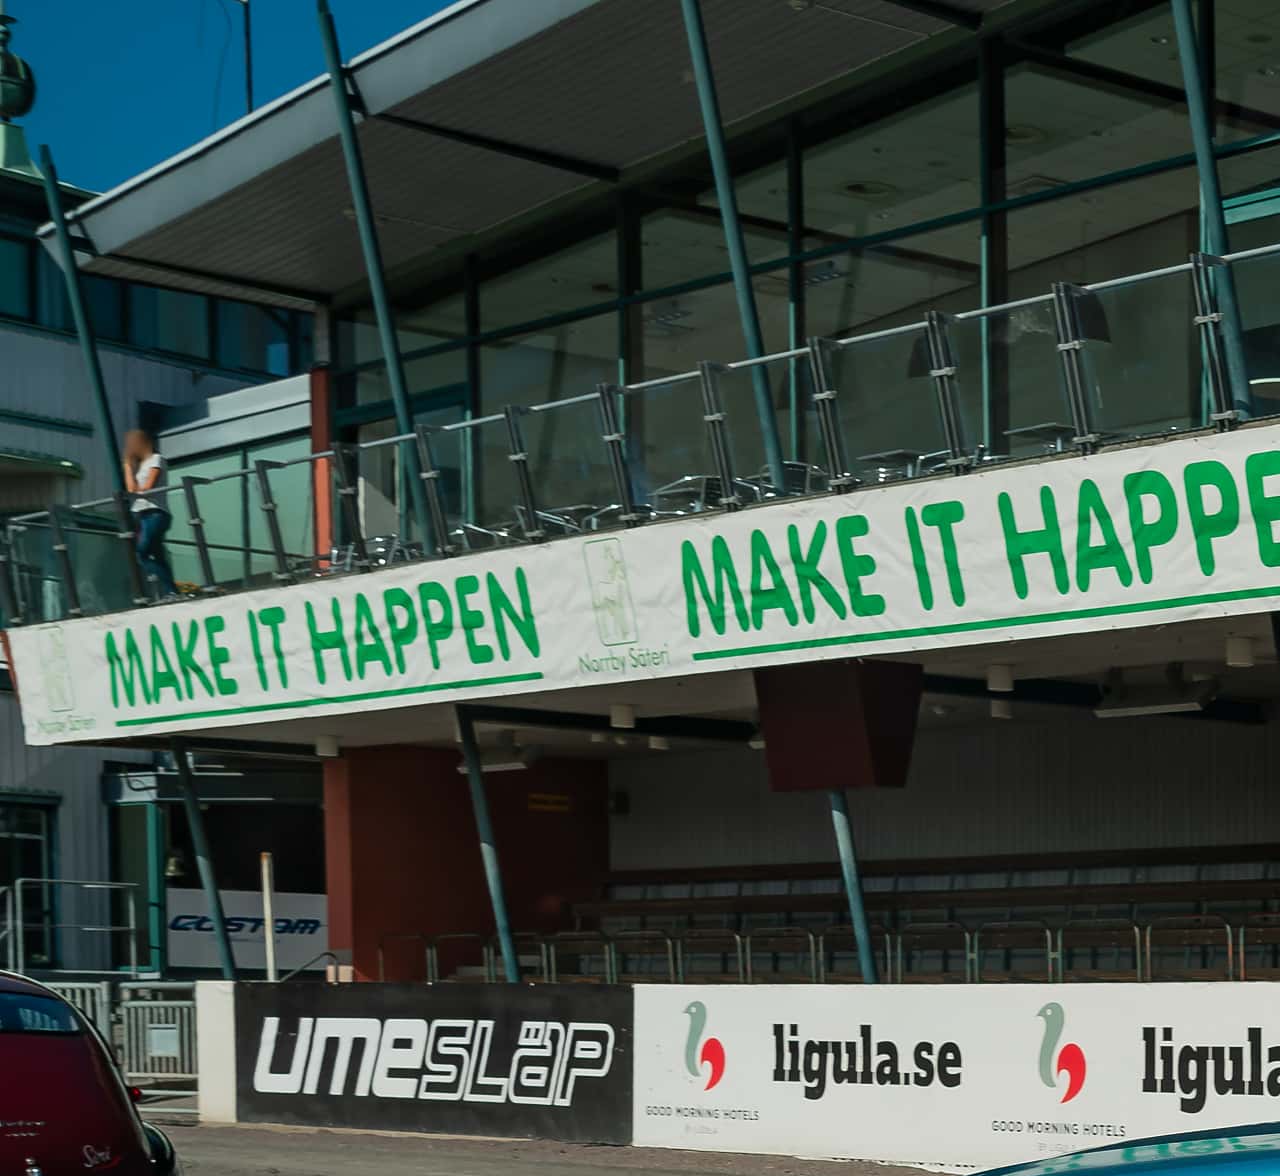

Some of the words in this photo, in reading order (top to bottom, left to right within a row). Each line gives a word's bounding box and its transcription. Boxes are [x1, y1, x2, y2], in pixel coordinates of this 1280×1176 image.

[682, 514, 887, 638] MAKE
[904, 500, 966, 610] IT
[104, 614, 239, 707] MAKE
[247, 606, 289, 690] IT
[304, 567, 541, 685] HAPPEN
[773, 1023, 962, 1101] ligula.se
[645, 1105, 672, 1117] GOOD
[675, 1107, 721, 1120] MORNING
[723, 1109, 760, 1121] HOTELS
[991, 1120, 1023, 1133] GOOD
[1027, 1121, 1079, 1135] MORNING
[1082, 1124, 1126, 1137] HOTELS
